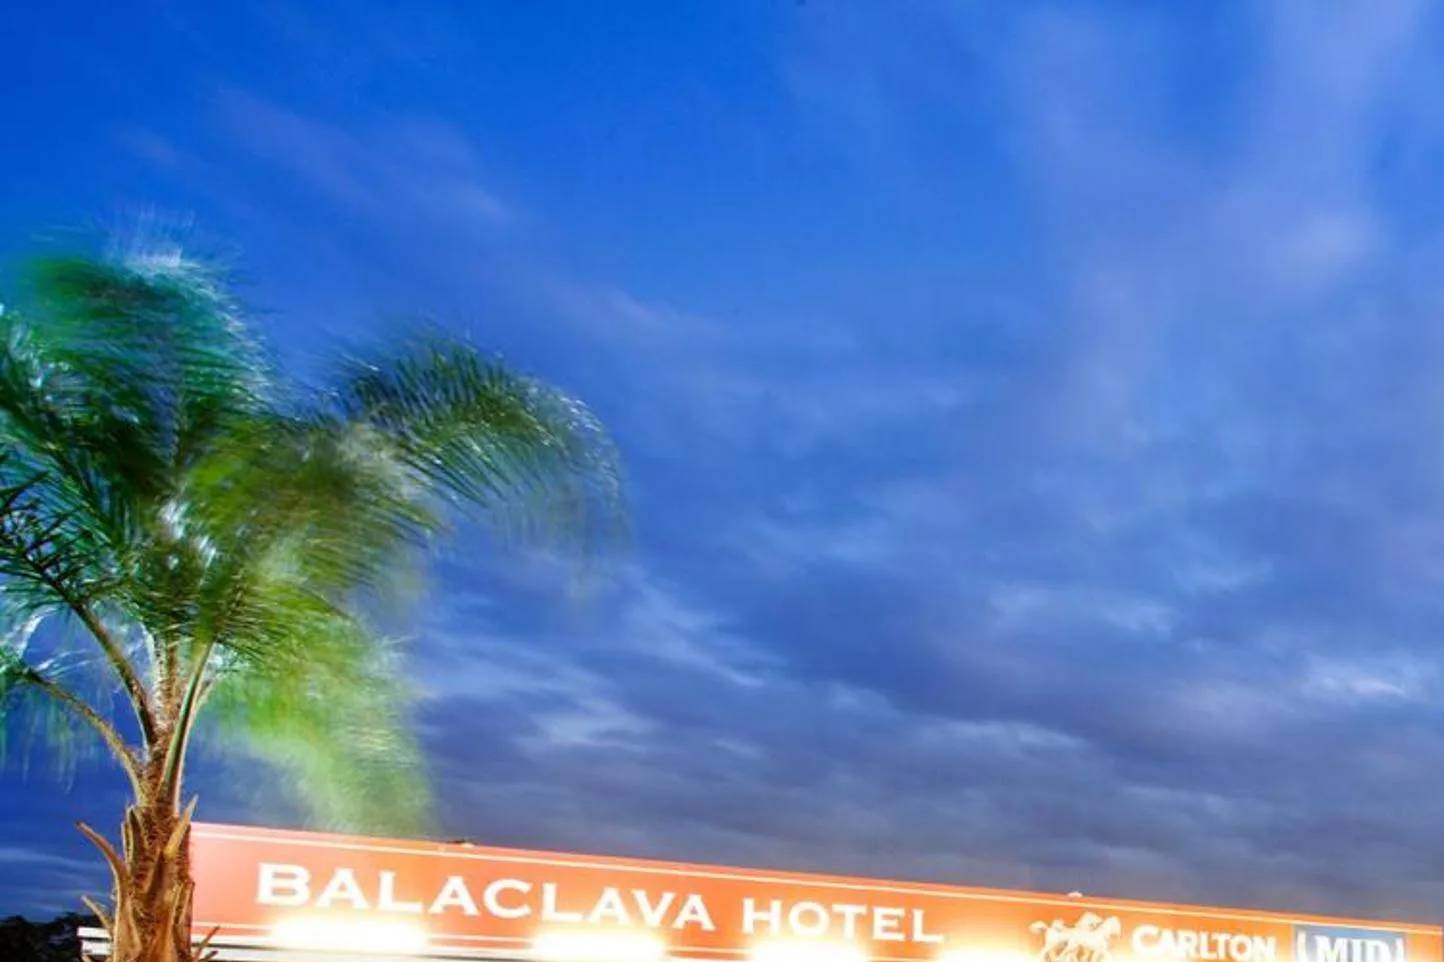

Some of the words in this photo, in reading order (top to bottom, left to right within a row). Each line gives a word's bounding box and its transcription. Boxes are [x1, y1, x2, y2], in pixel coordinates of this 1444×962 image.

[256, 861, 715, 931] BALACLAVA
[742, 897, 944, 943] HOTEL
[1131, 924, 1277, 962] CARLTON
